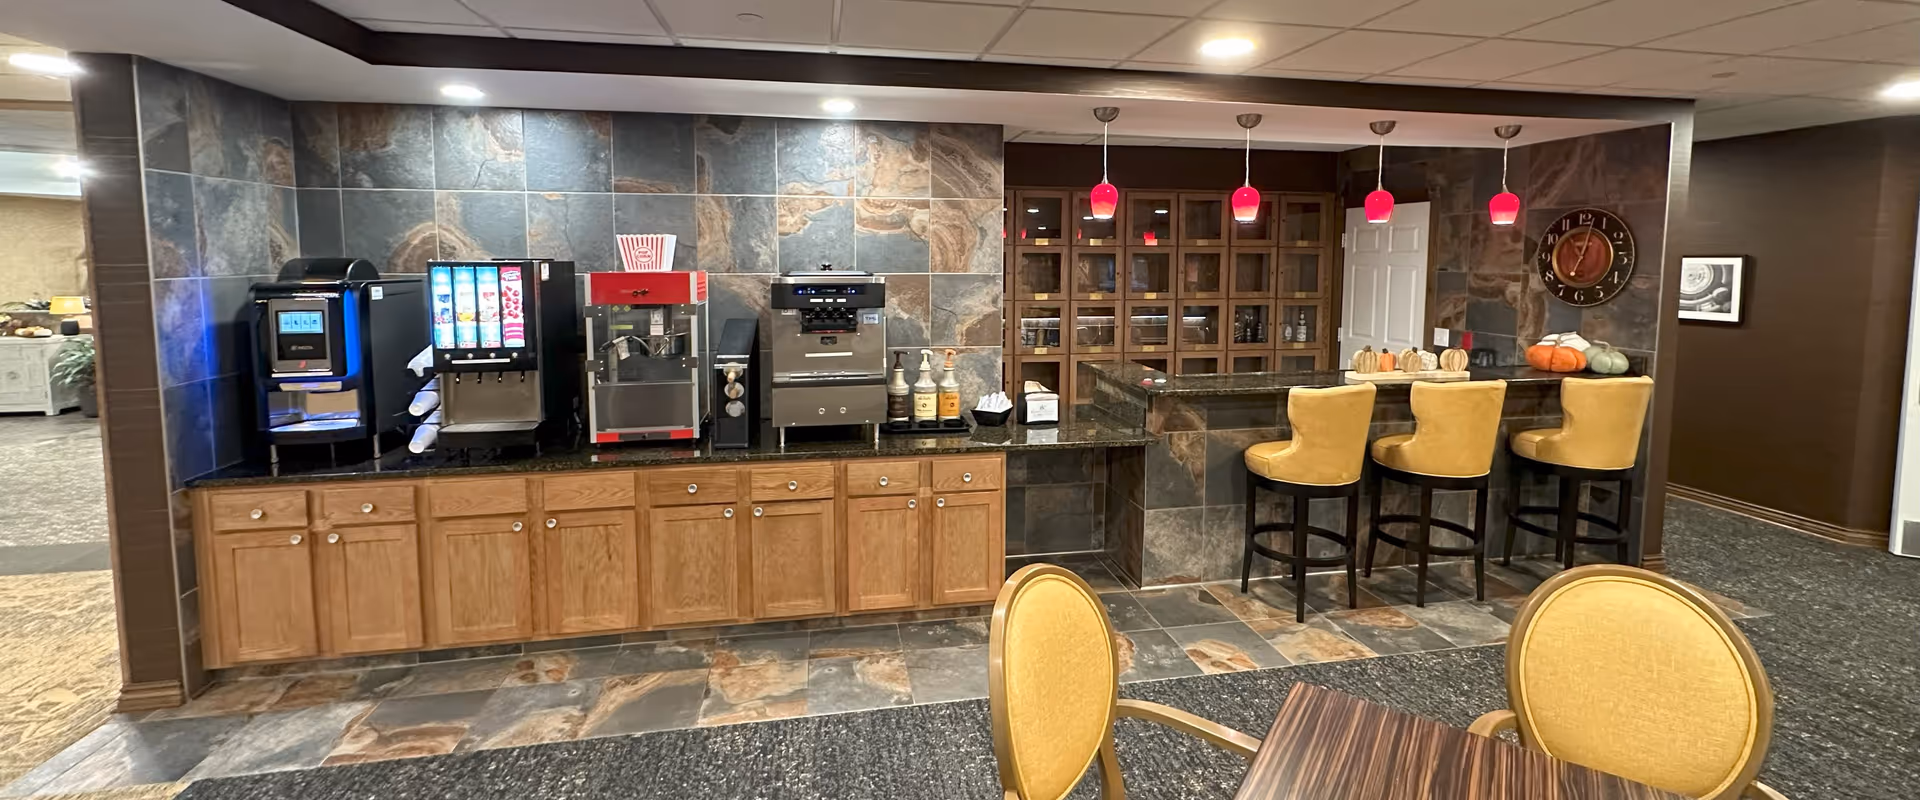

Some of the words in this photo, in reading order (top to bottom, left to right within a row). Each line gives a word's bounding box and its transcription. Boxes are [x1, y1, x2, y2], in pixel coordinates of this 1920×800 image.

[1561, 219, 1570, 231] 11
[1579, 213, 1592, 225] 12
[1602, 217, 1606, 230] 1
[1547, 233, 1558, 245] 10
[1613, 231, 1623, 244] 2
[1542, 252, 1550, 263] 9
[1618, 252, 1628, 265] 3
[1545, 270, 1554, 282] 8
[1608, 271, 1623, 284] 4
[1558, 284, 1566, 297] 7
[1574, 290, 1584, 302] 6
[1595, 286, 1604, 298] 5
